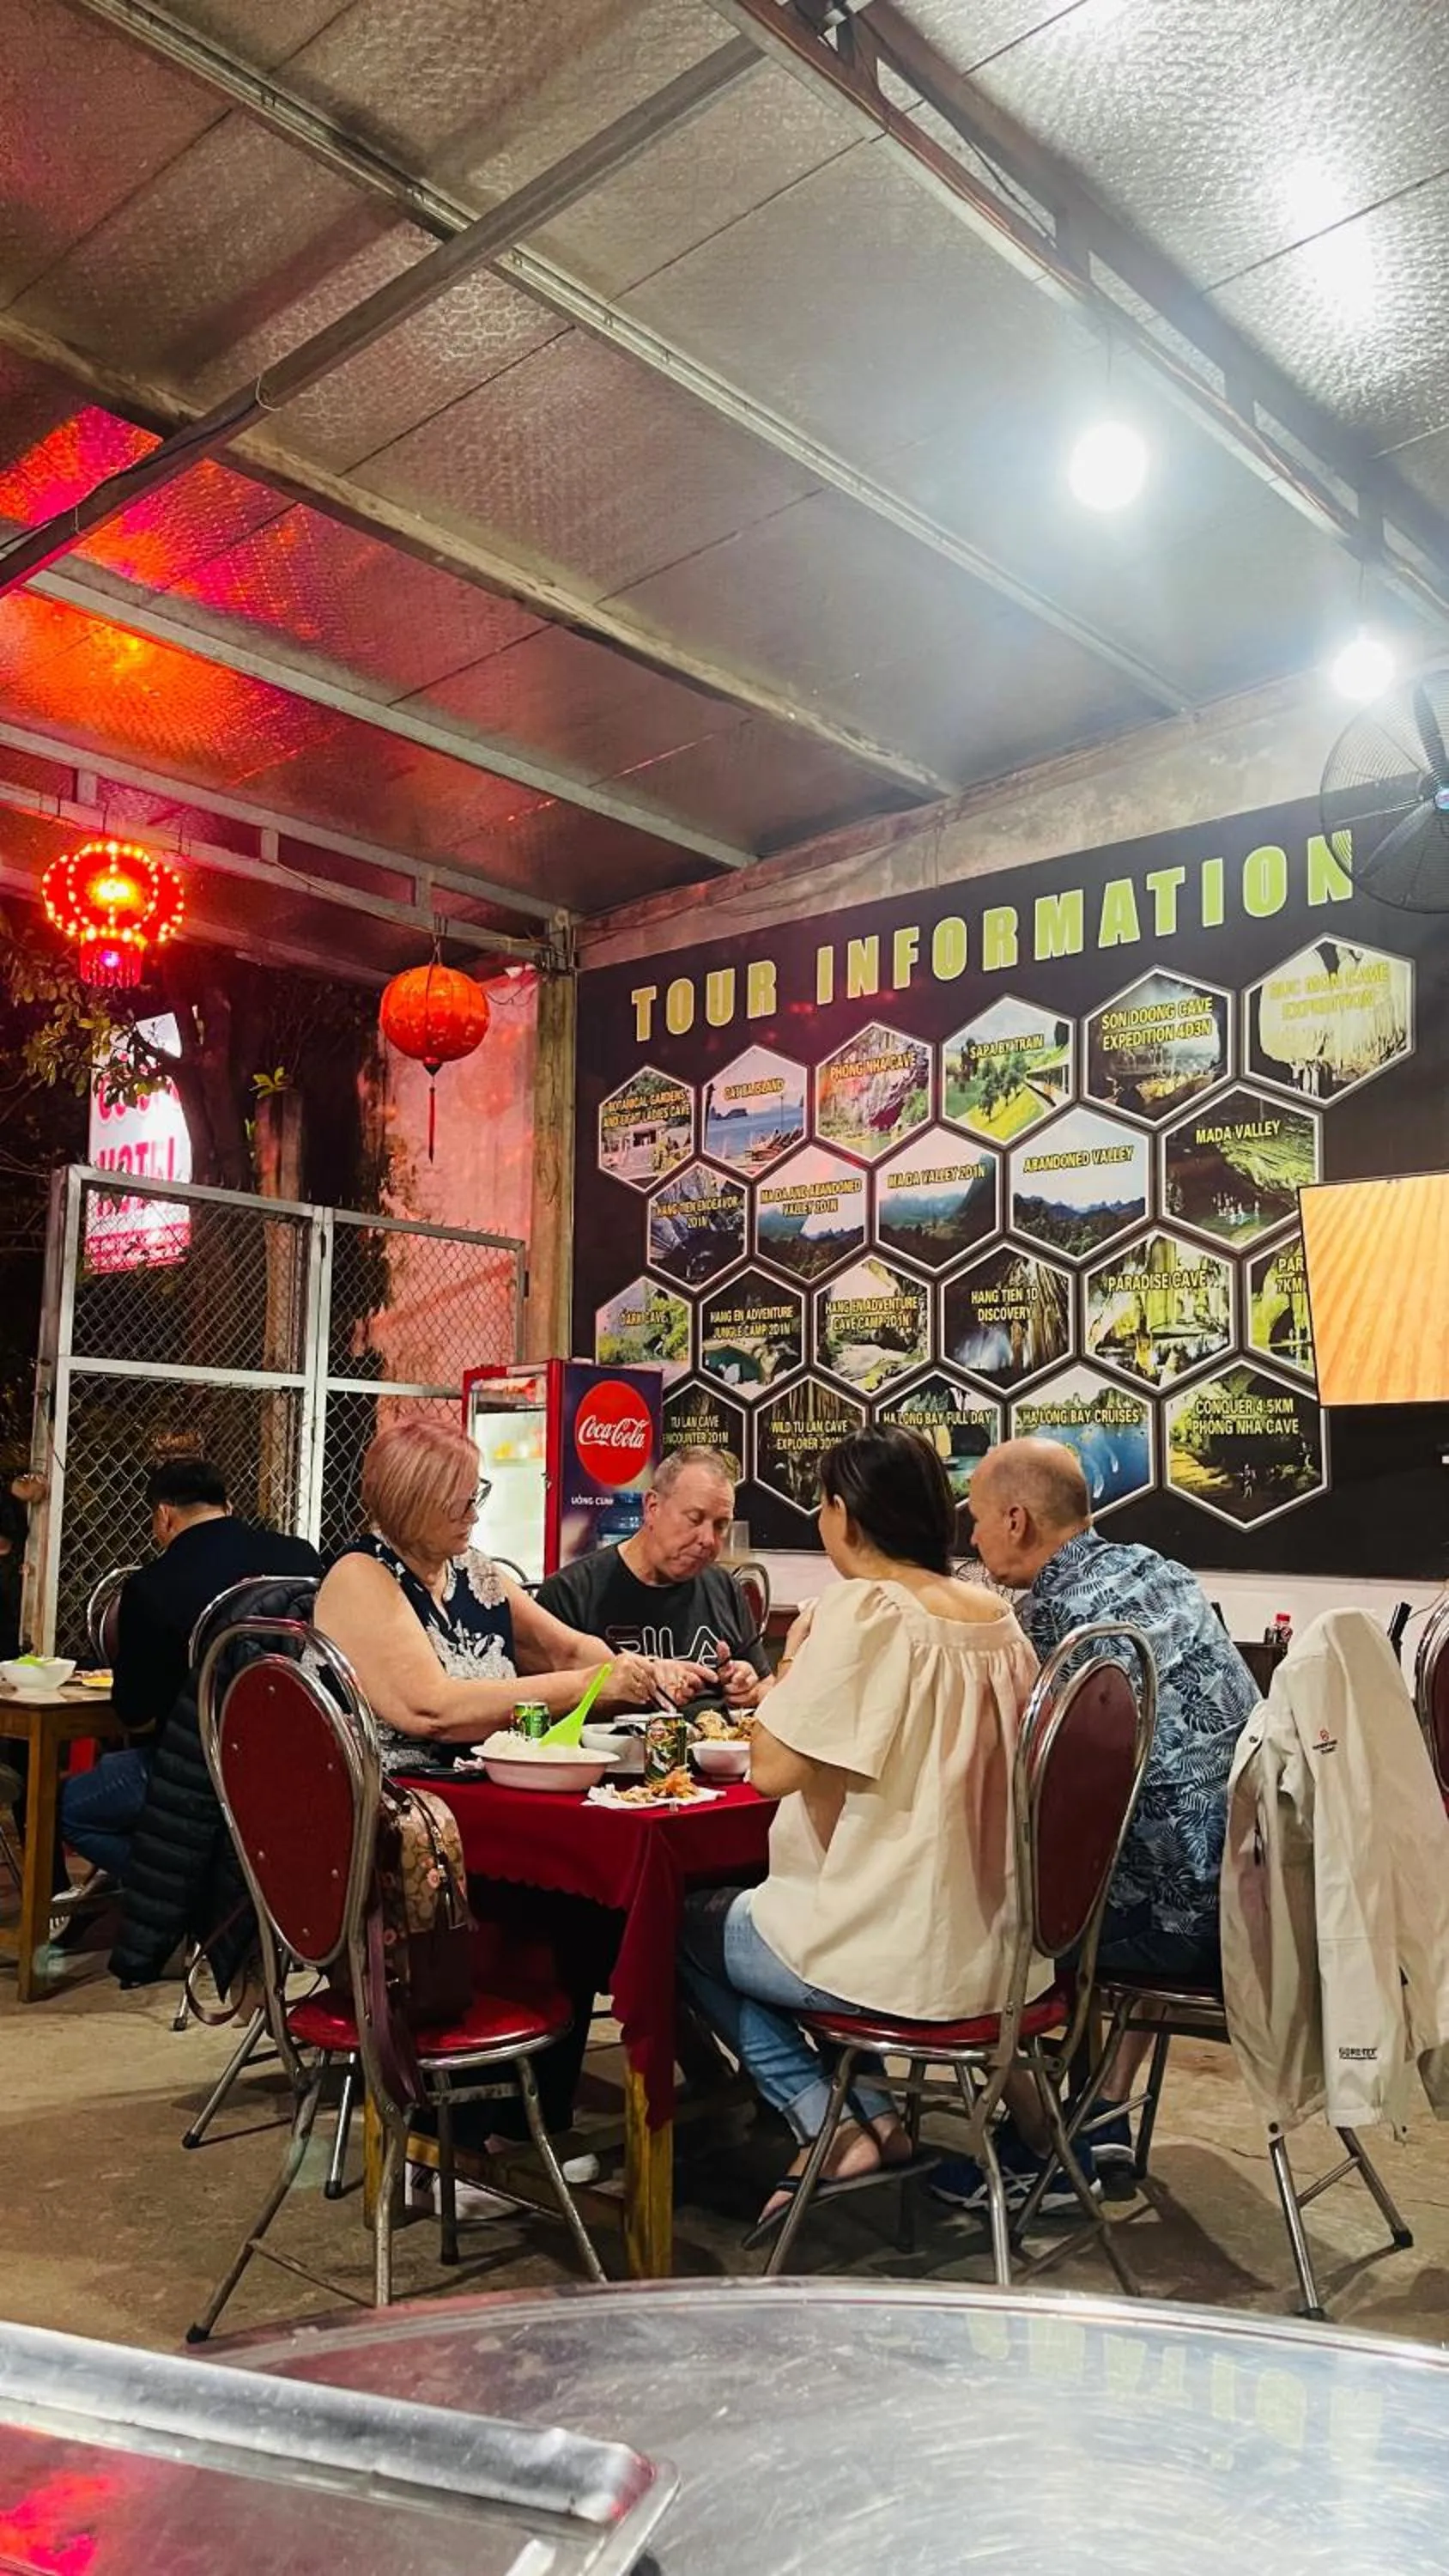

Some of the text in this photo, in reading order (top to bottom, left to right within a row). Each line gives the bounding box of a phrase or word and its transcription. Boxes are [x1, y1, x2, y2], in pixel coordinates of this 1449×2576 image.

[631, 828, 1354, 1042] TOUR INFORMATION
[1101, 997, 1213, 1030] SON DOONG CAVE
[1102, 1019, 1212, 1051] EXPEDITION 4D3N
[969, 1034, 1044, 1059] SAPA BY TRAIN
[830, 1060, 863, 1082] PHONG
[889, 1052, 916, 1071] CAVE
[1195, 1120, 1282, 1145] MADA VALLEY
[1023, 1145, 1136, 1173] ABANDONED VALLEY
[922, 1165, 959, 1184] VALLEY
[1277, 1256, 1305, 1273] PAR
[1107, 1269, 1208, 1292] PARADISE CAVE
[971, 1289, 999, 1304] HANG
[1001, 1288, 1023, 1303] TIEN
[710, 1305, 794, 1323] HANG EN ADVENTURE
[825, 1299, 850, 1315] HANG
[864, 1296, 919, 1313] ADVENTURE
[977, 1306, 1032, 1322] DISCOVERY
[743, 1323, 768, 1338] CAMP
[769, 1322, 791, 1336] 2D1N
[834, 1316, 857, 1331] CAVE
[858, 1314, 884, 1330] CAMP
[1194, 1397, 1253, 1416] CONQUER
[670, 1415, 719, 1429] TU LAN CAVE
[899, 1412, 924, 1425] LONG
[925, 1412, 944, 1425] BAY
[947, 1411, 968, 1425] FULL
[971, 1411, 992, 1425] DAY
[1040, 1409, 1067, 1424] LONG
[1070, 1409, 1091, 1424] BAY
[1094, 1409, 1139, 1423] CRUISES
[578, 1414, 650, 1449] Coca-Cola
[772, 1419, 848, 1434] WILD TU LAN CAVE
[1191, 1418, 1300, 1436] PHONG NHA CAVE
[663, 1431, 729, 1444] ENCOUNTER 2D1N
[777, 1437, 819, 1451] EXPLORER
[605, 1625, 721, 1669] FILA
